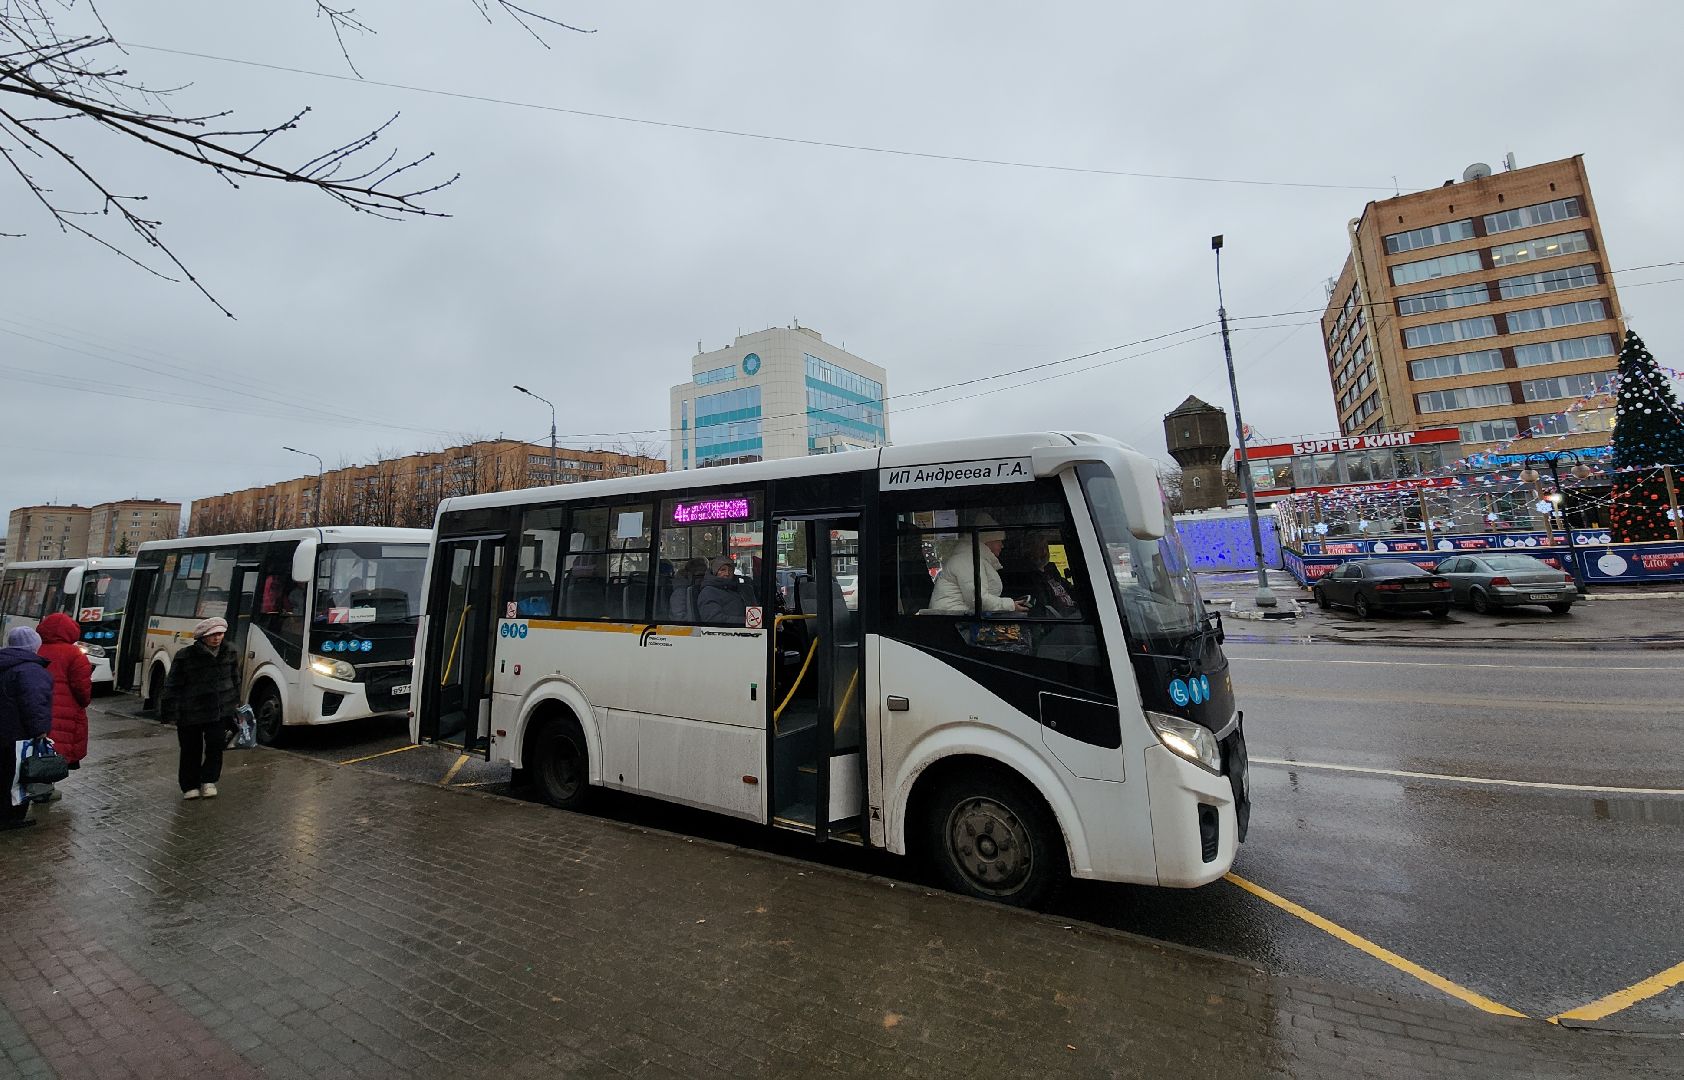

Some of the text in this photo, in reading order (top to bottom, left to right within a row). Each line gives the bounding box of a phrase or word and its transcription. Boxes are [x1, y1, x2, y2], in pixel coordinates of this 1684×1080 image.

[1293, 432, 1416, 455] БУРГЕР КИНГ
[888, 461, 1028, 485] ИП Андреева Г.А.
[80, 608, 102, 622] 25
[330, 609, 348, 623] 7
